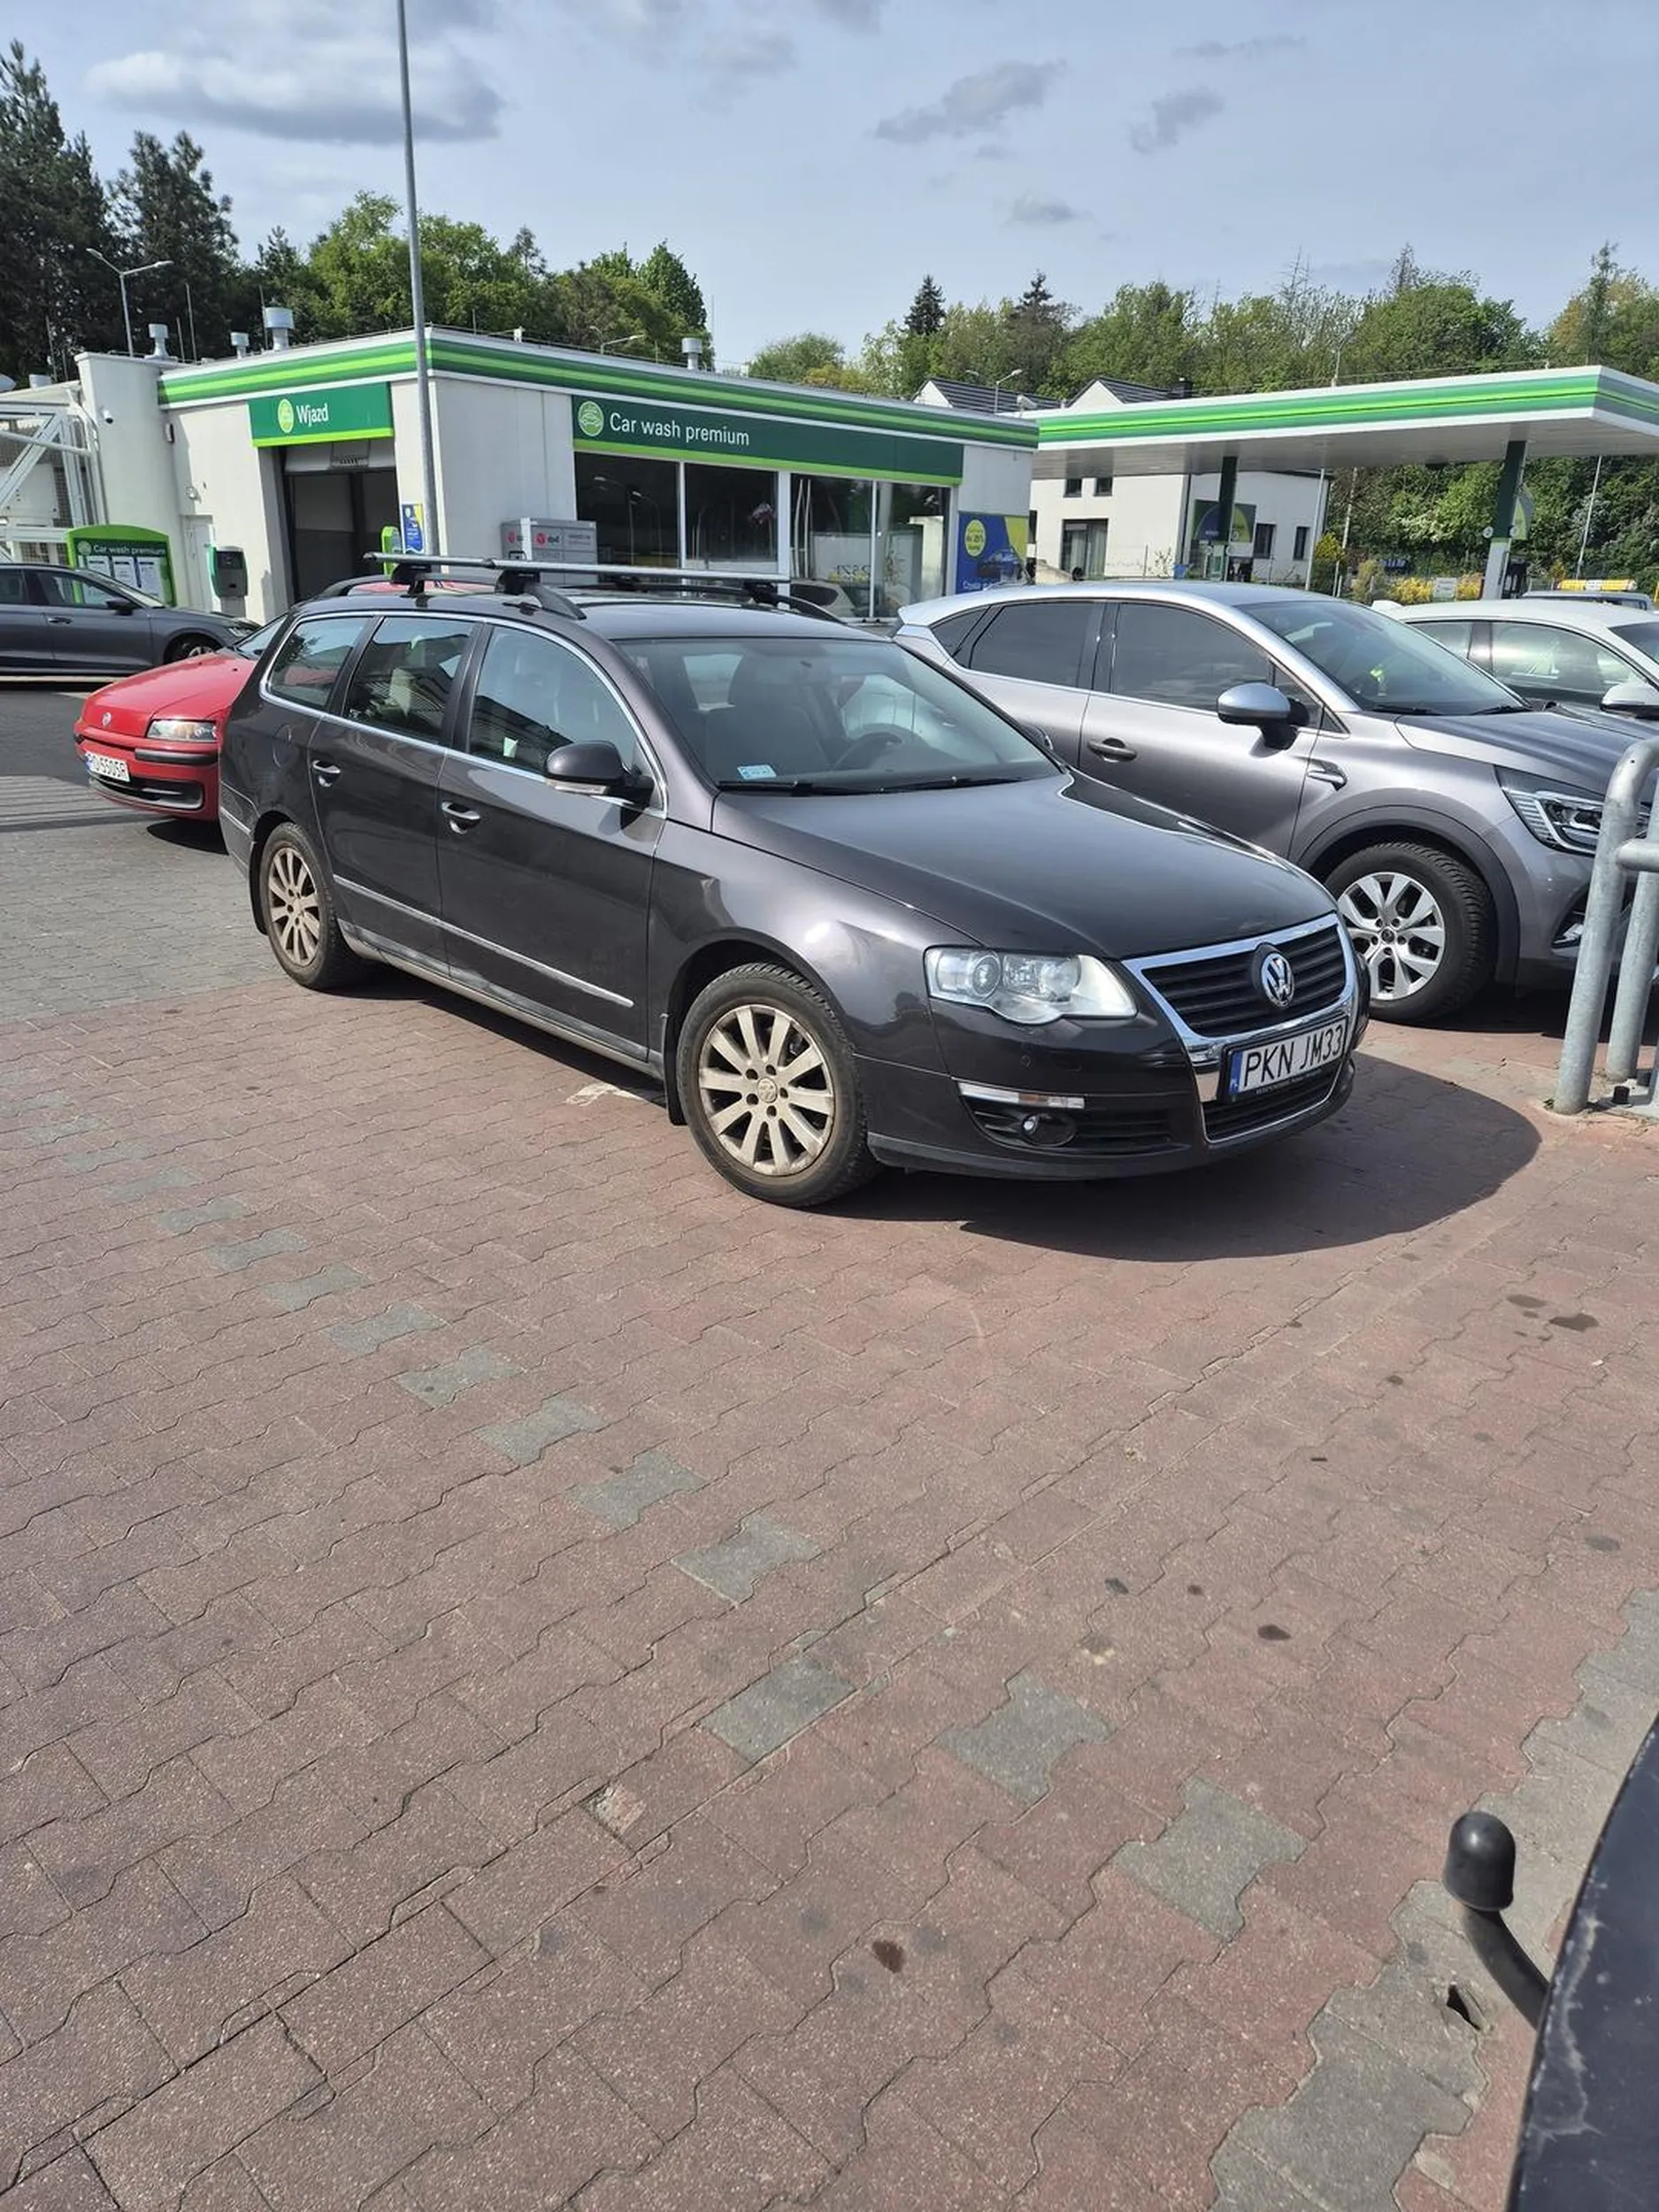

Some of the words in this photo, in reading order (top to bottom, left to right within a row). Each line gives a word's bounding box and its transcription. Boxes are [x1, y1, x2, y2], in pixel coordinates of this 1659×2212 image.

[296, 403, 329, 427] Wjazd
[610, 412, 636, 433] Car
[641, 420, 681, 438] wash
[686, 426, 749, 445] premium
[93, 544, 107, 553] Car
[1244, 1041, 1294, 1087] PKN
[1299, 1024, 1343, 1070] JM33
